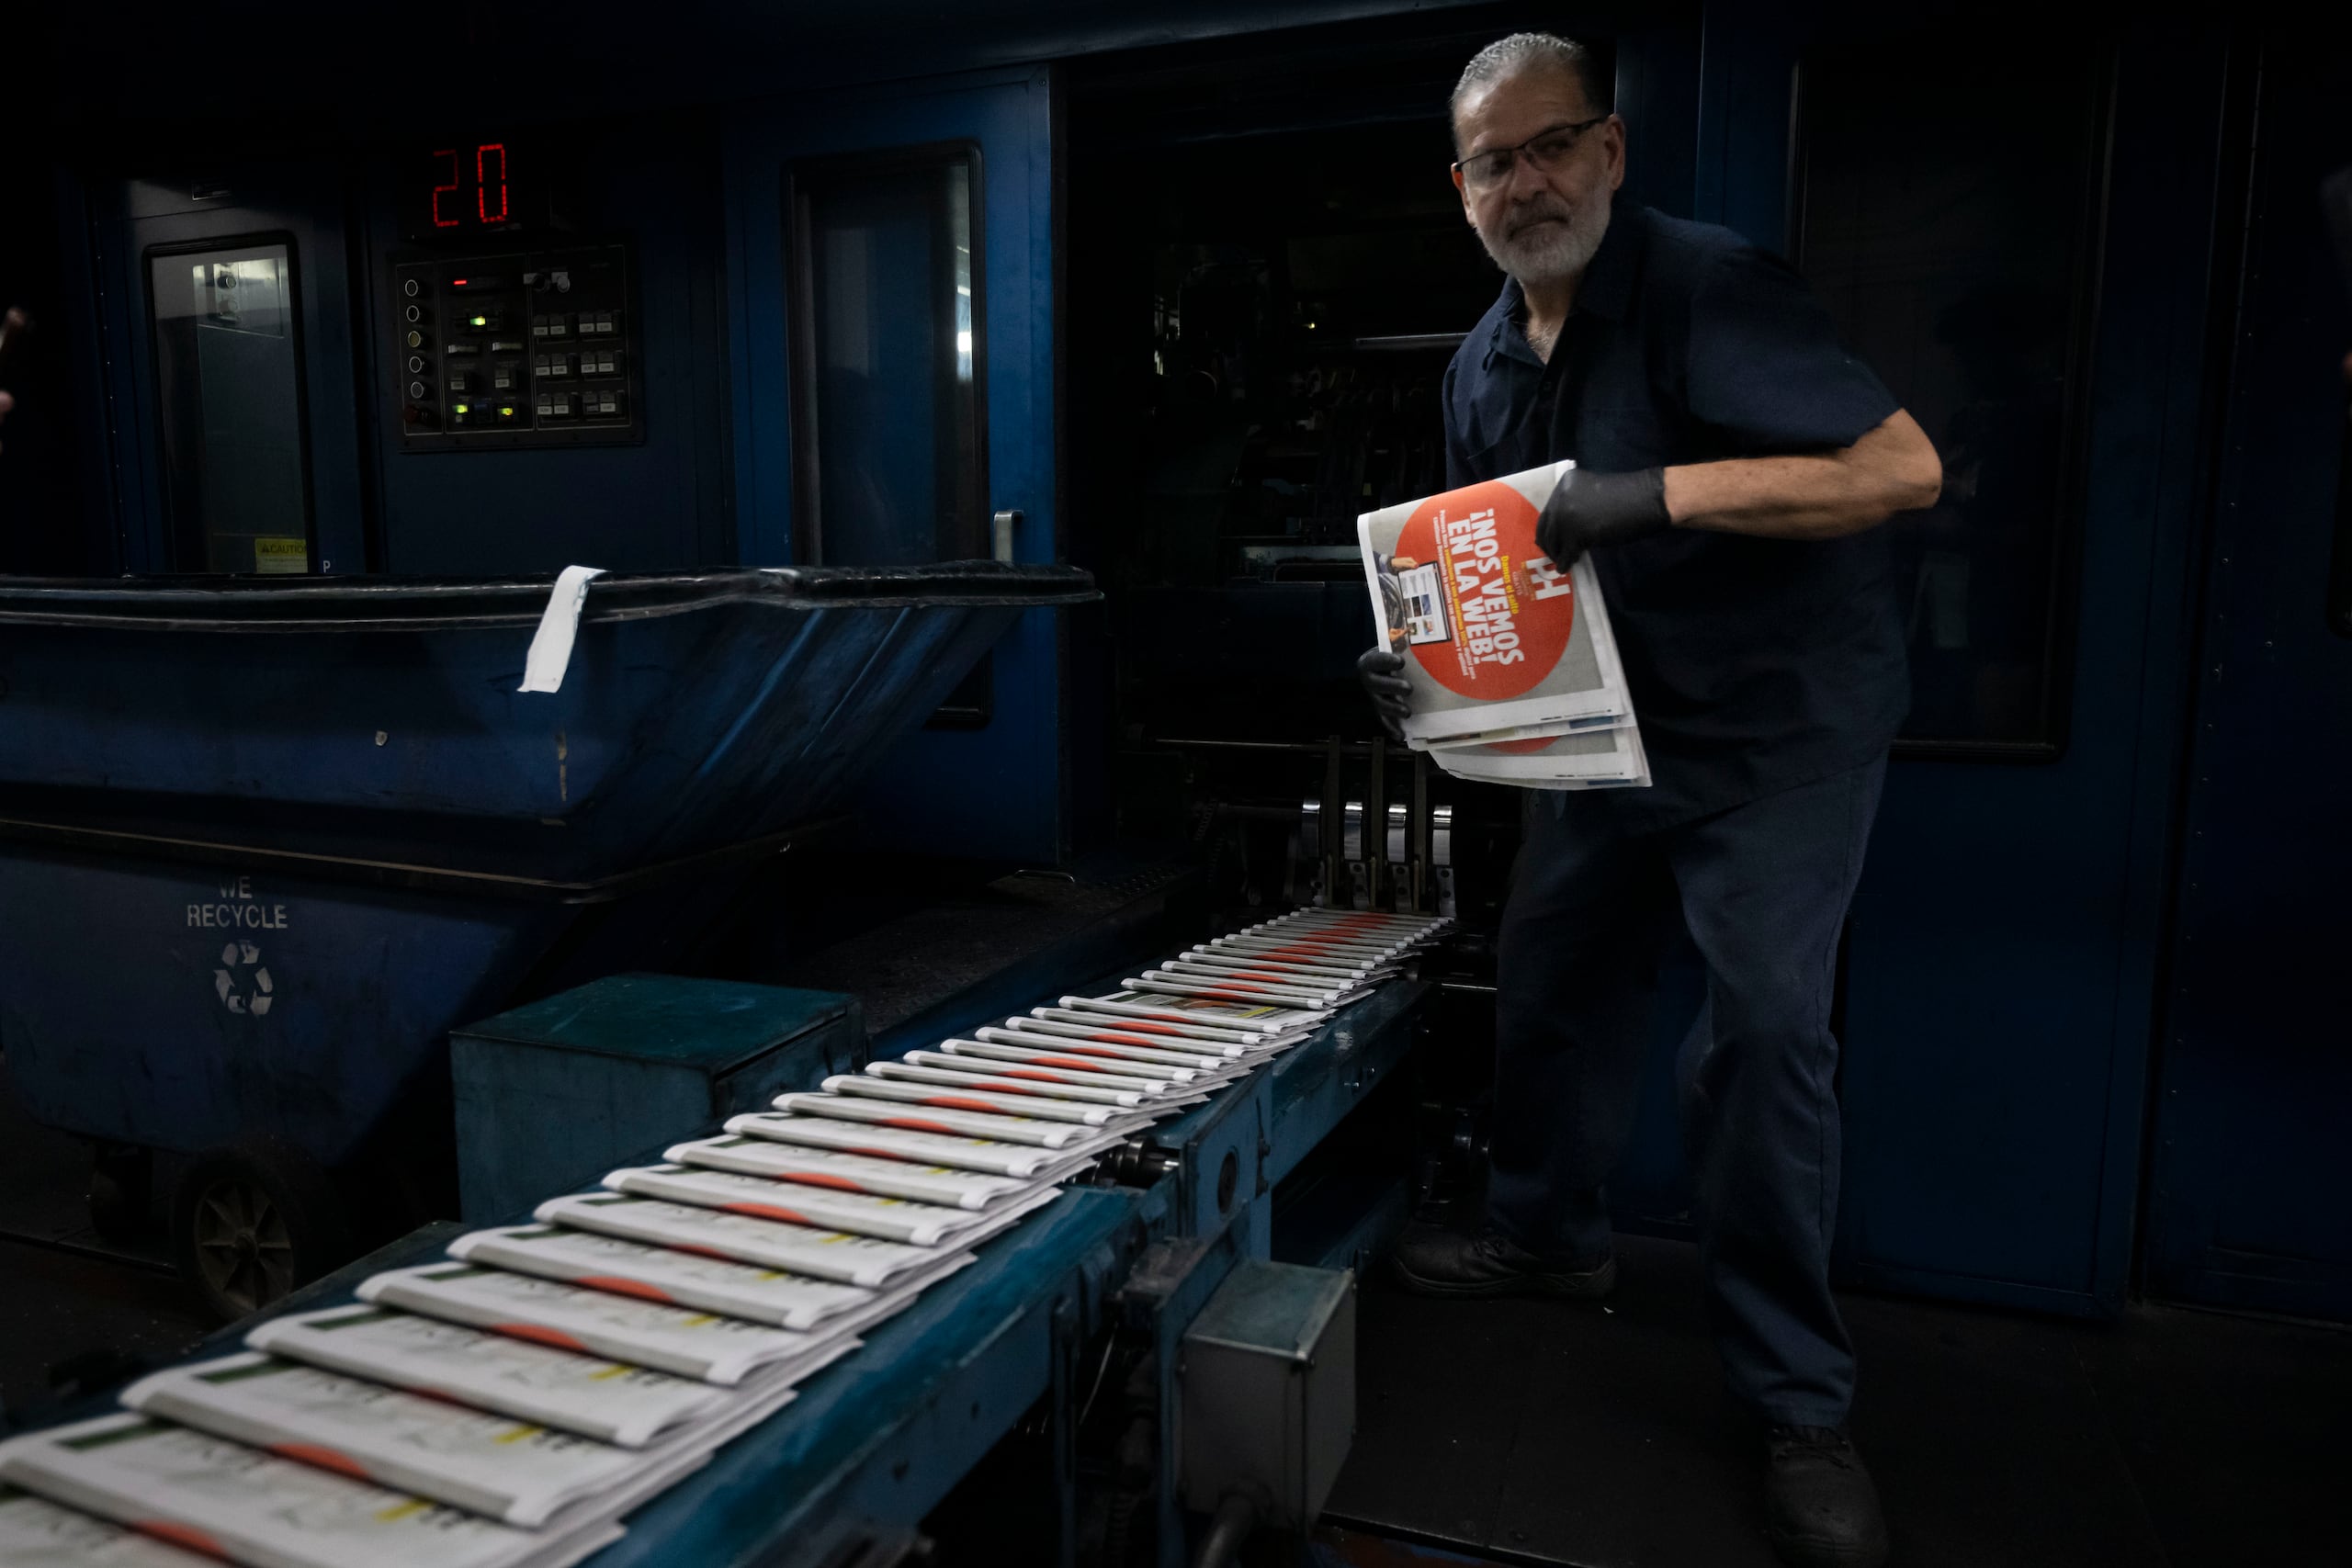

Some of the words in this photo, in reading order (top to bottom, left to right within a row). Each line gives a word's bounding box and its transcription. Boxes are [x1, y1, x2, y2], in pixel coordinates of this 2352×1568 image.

[432, 143, 507, 228] 20
[1447, 519, 1474, 555] EN
[1470, 508, 1502, 574] ¡NOS
[1454, 559, 1480, 592] LA
[1500, 555, 1511, 583] Damos
[1505, 584, 1514, 593] el
[1507, 594, 1520, 615] salto
[1461, 595, 1498, 665] WEB!
[1481, 577, 1524, 665] VEMOS
[220, 874, 253, 899] WE
[187, 903, 288, 929] RECYCLE
